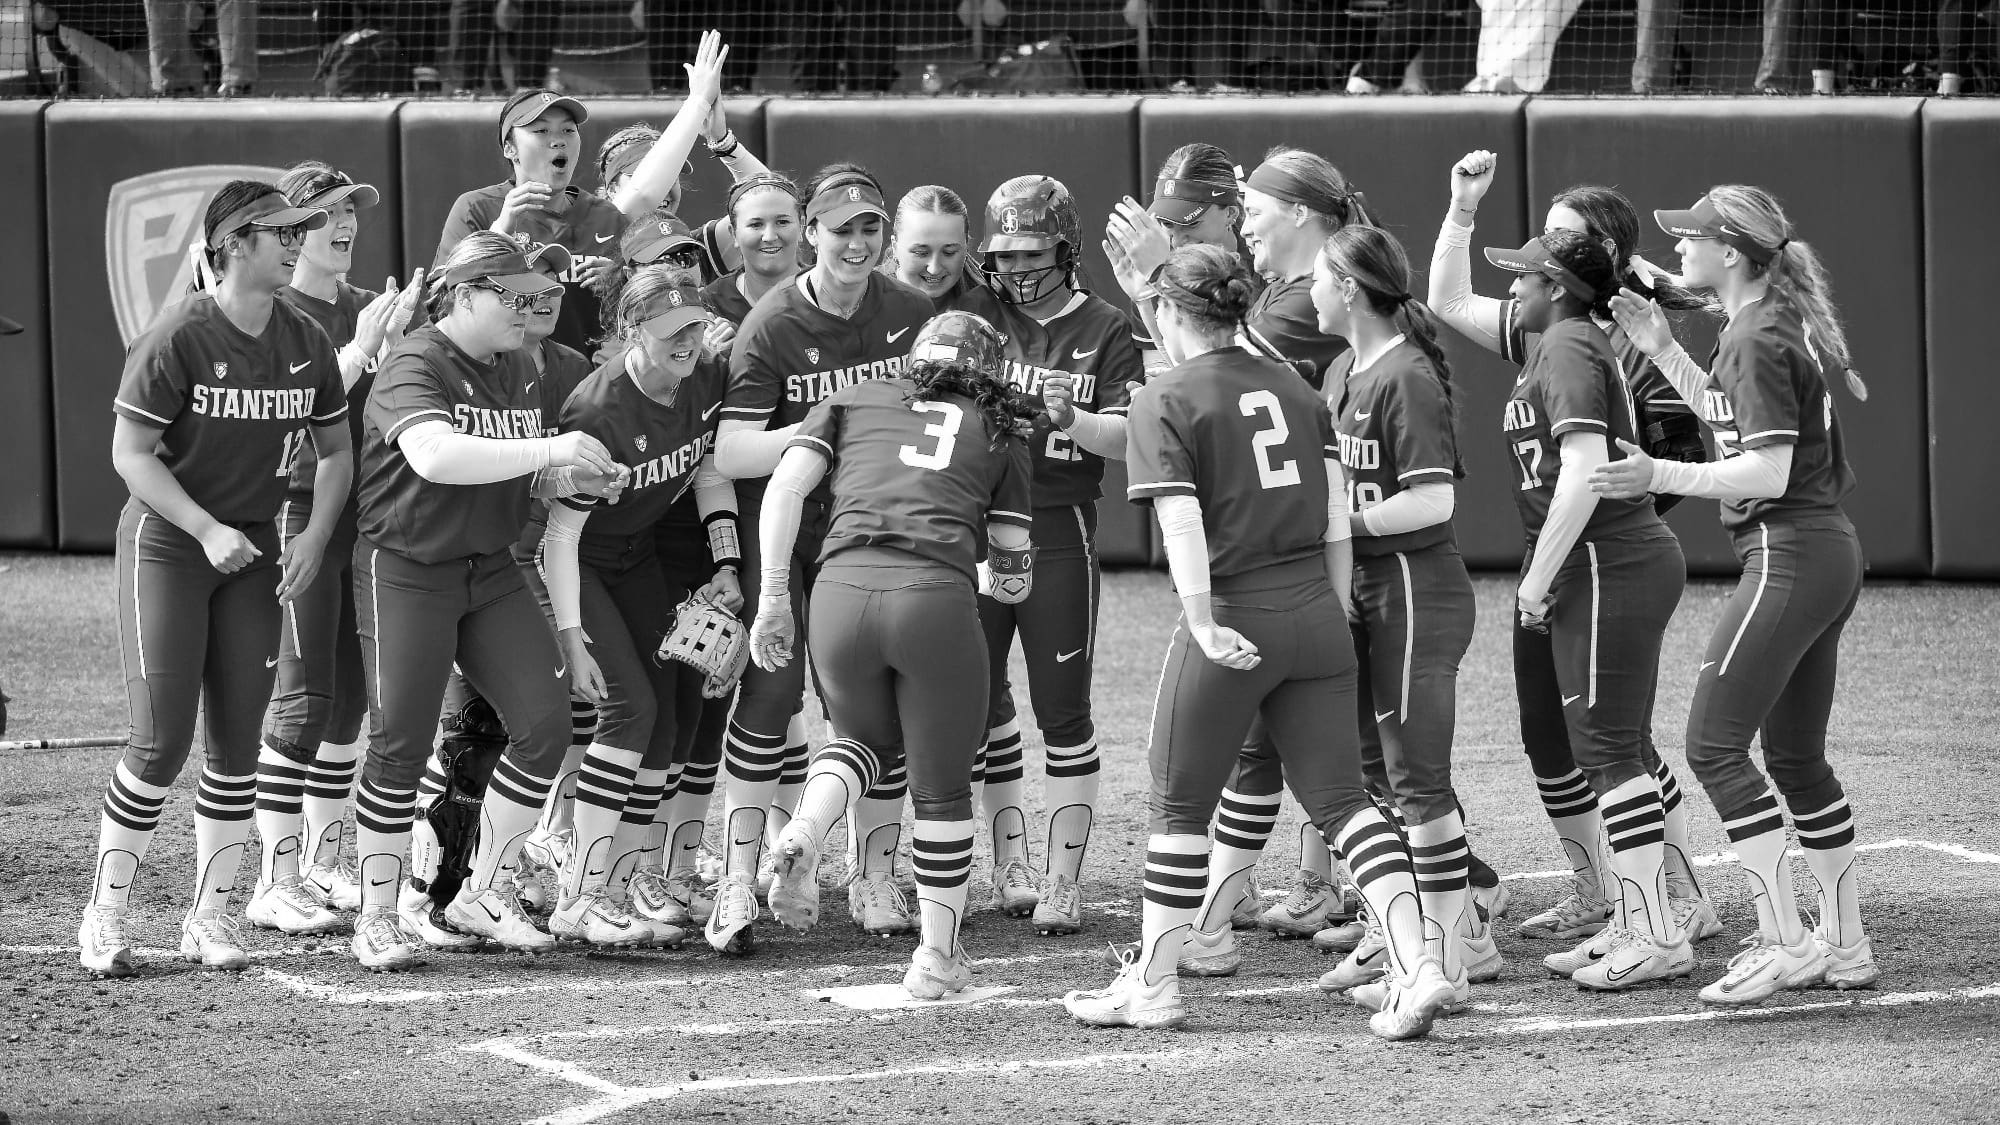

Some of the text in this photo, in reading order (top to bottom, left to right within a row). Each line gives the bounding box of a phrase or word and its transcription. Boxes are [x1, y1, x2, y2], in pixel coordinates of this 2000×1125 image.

[192, 383, 316, 420] STANFORD
[899, 400, 963, 471] 3
[1238, 389, 1302, 490] 2
[1512, 438, 1543, 491] 17
